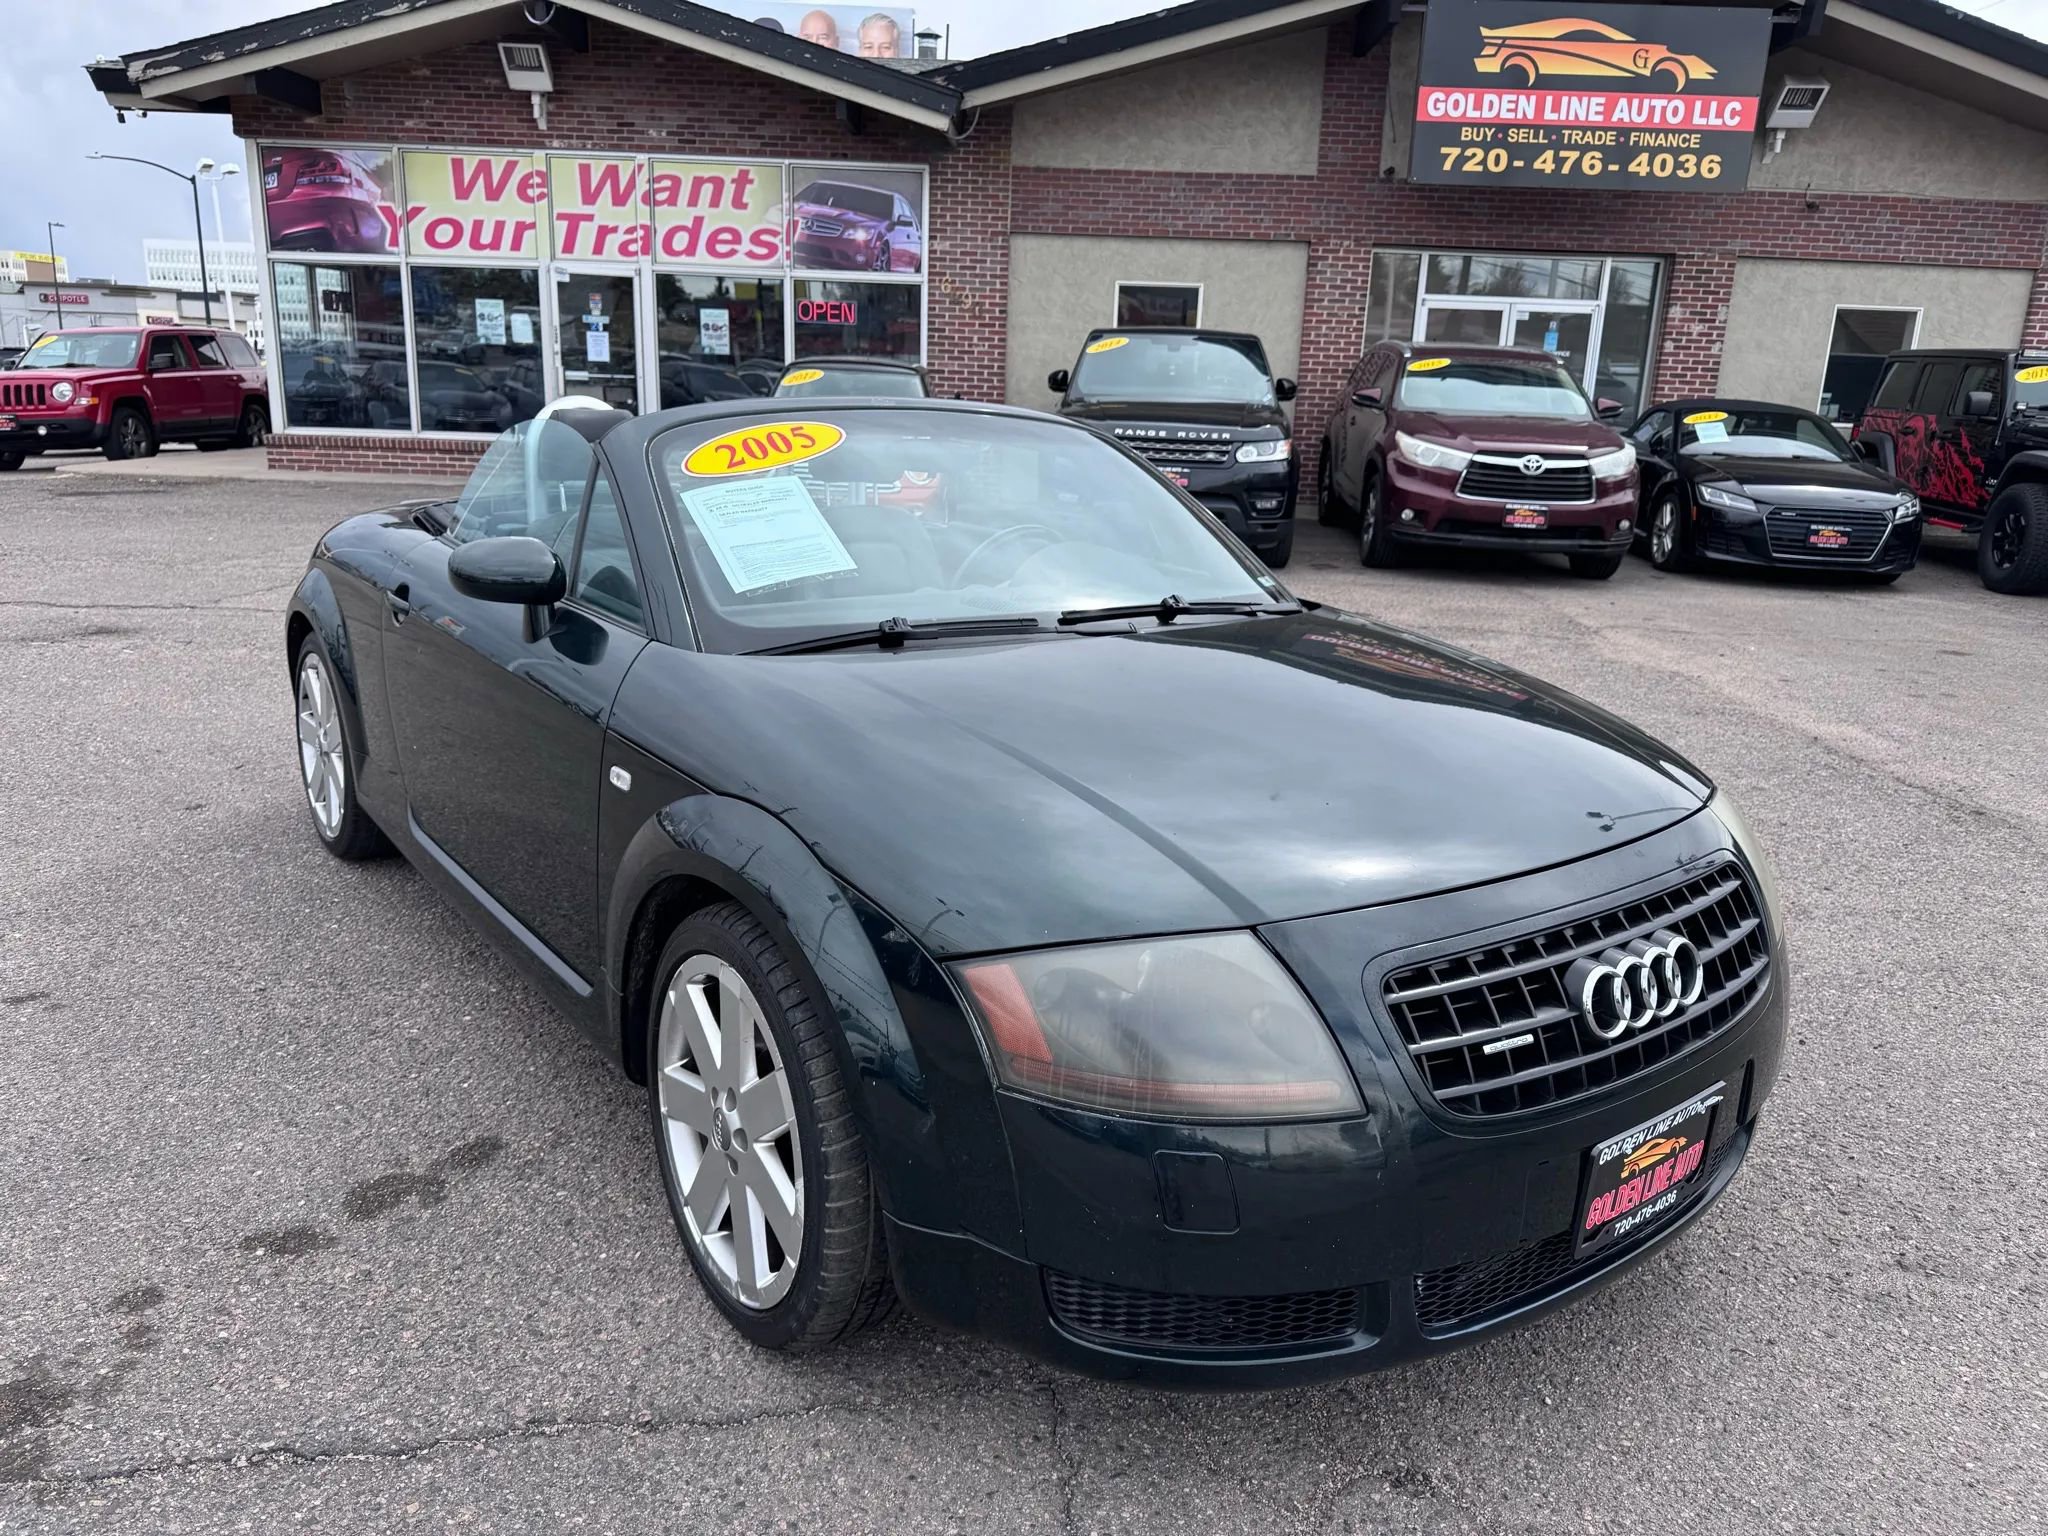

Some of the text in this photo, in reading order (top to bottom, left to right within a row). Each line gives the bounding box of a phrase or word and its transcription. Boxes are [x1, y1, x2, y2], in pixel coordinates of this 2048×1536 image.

[1427, 91, 1743, 127] GOLDEN LINE AUTO LLC
[1460, 127, 1702, 148] BUY SELL TRADE FINANCE
[450, 158, 755, 211] We Want
[377, 205, 537, 252] Your
[798, 300, 856, 325] OPEN
[714, 426, 817, 469] 2005
[1114, 427, 1231, 440] RANGE ROVER
[1645, 1115, 1674, 1141] LINE
[1586, 1139, 1704, 1230] GOLDEN LINE AUTO
[1614, 1189, 1678, 1237] 720-476-4036
